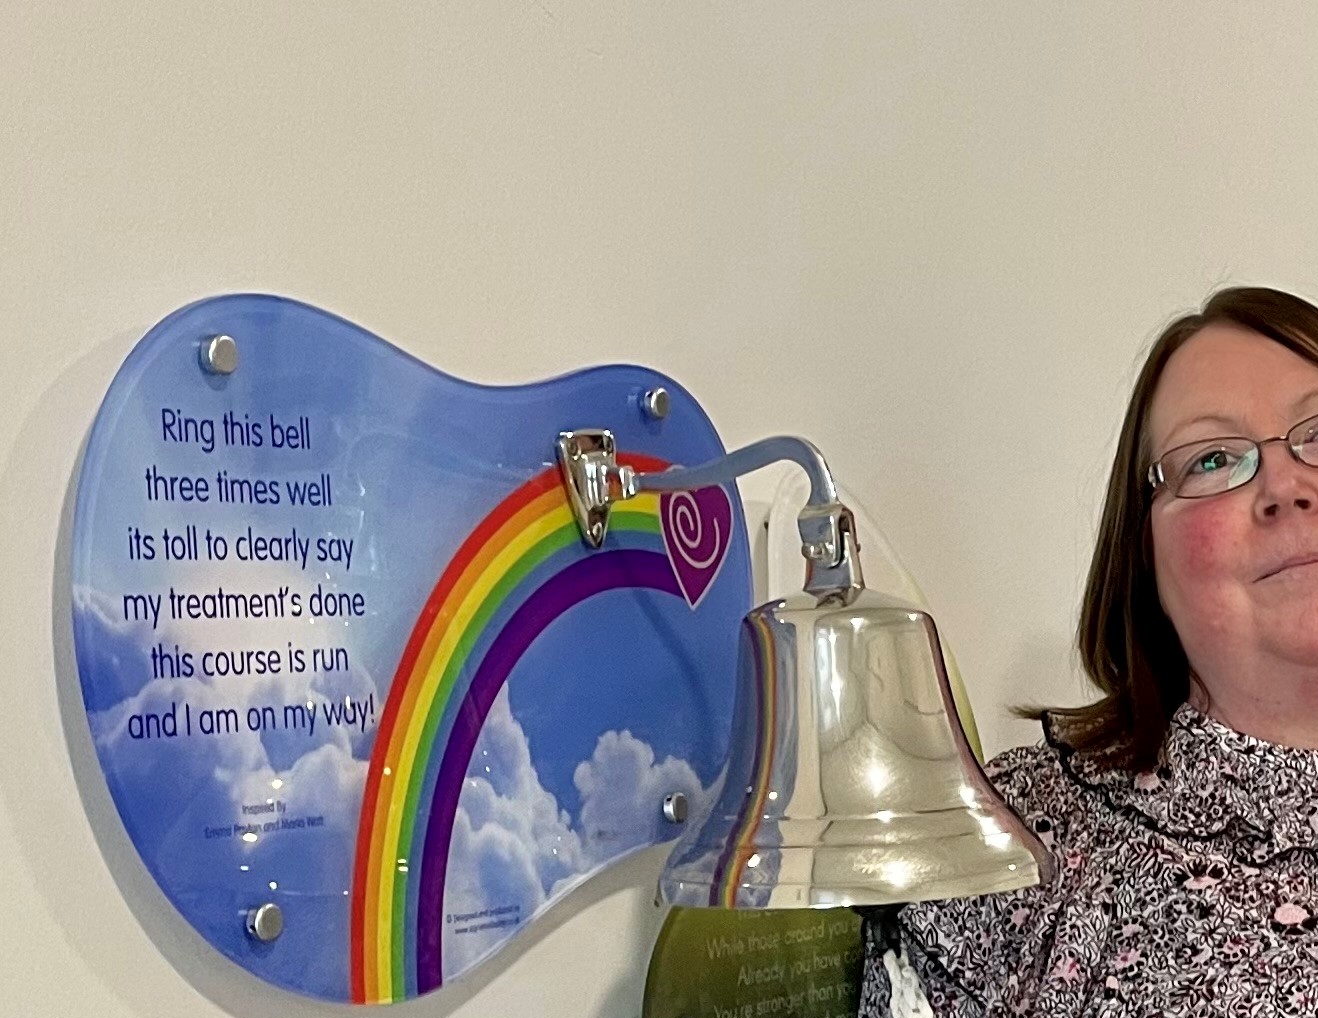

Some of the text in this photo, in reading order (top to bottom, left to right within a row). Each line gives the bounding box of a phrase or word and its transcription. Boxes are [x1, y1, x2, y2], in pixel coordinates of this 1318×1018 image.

[161, 408, 311, 454] Ring this bell
[145, 464, 332, 507] three times well
[128, 524, 354, 572] its toll to clearly say
[123, 583, 366, 630] my treatment's done
[151, 642, 349, 679] this course is run
[128, 693, 375, 739] and I am on my way!
[785, 920, 825, 945] around
[828, 921, 848, 941] you
[737, 960, 785, 986] Already
[790, 960, 811, 979] you
[814, 949, 841, 968] have
[808, 982, 833, 1003] than
